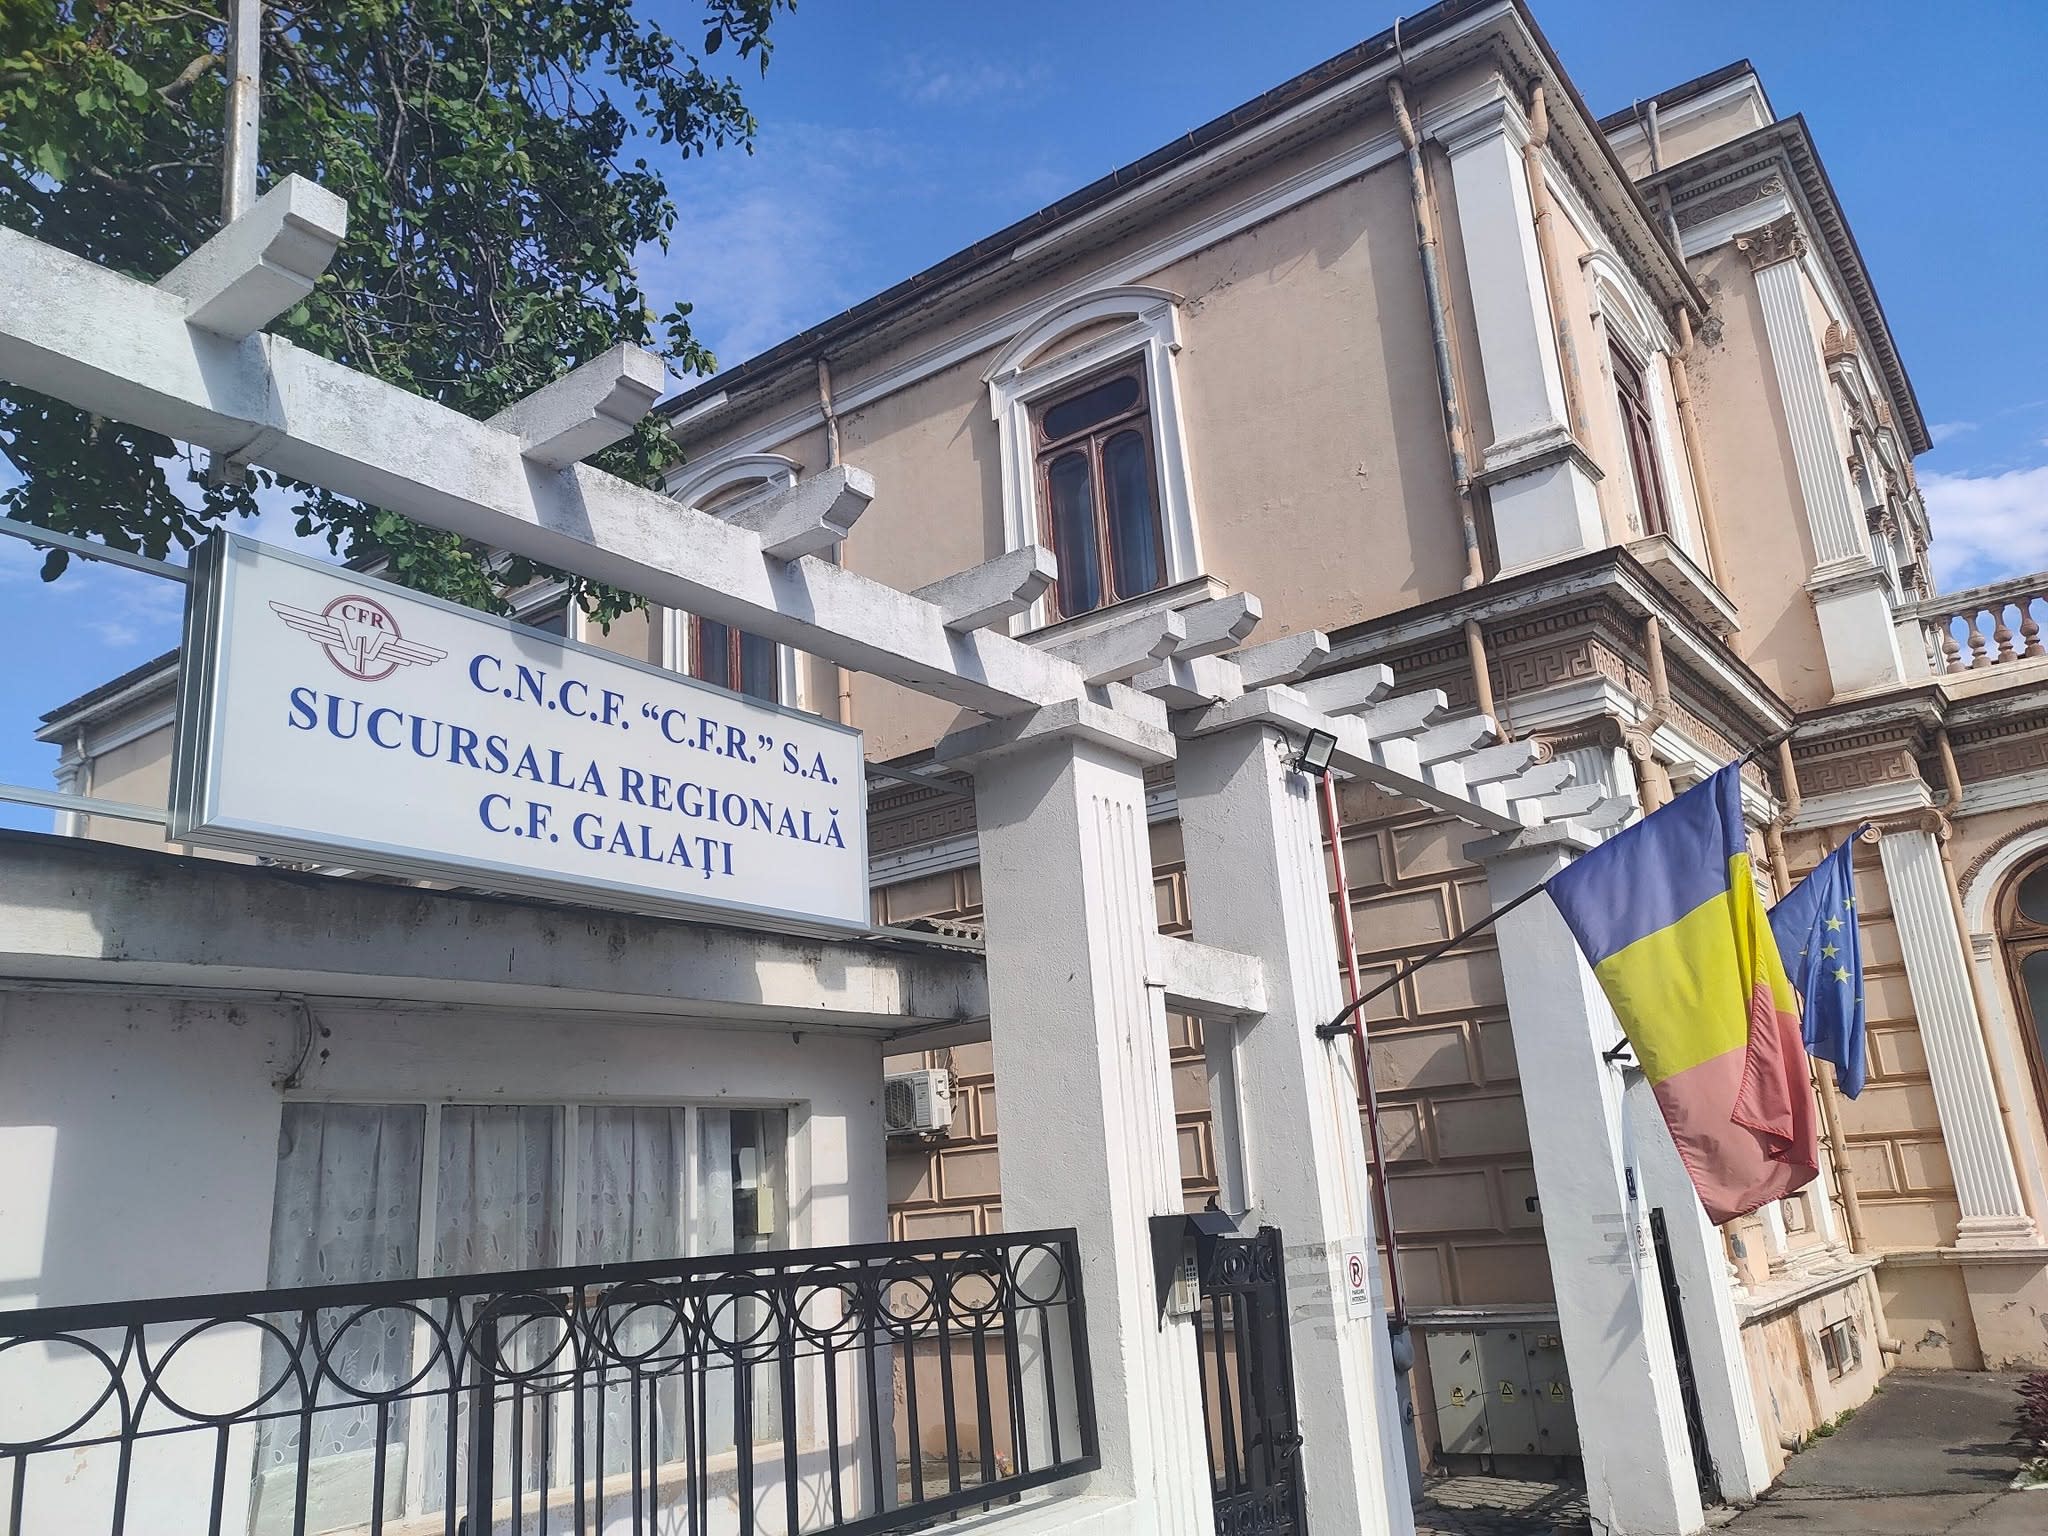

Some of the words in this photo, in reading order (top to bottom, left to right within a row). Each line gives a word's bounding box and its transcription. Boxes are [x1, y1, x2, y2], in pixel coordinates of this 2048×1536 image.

[342, 604, 384, 629] CFR
[469, 654, 630, 730] C.N.C.F.
[783, 741, 838, 785] S.A.
[288, 686, 608, 799] SUCURSALA
[618, 766, 846, 850] REGIONALĂ
[478, 793, 559, 843] C.F.
